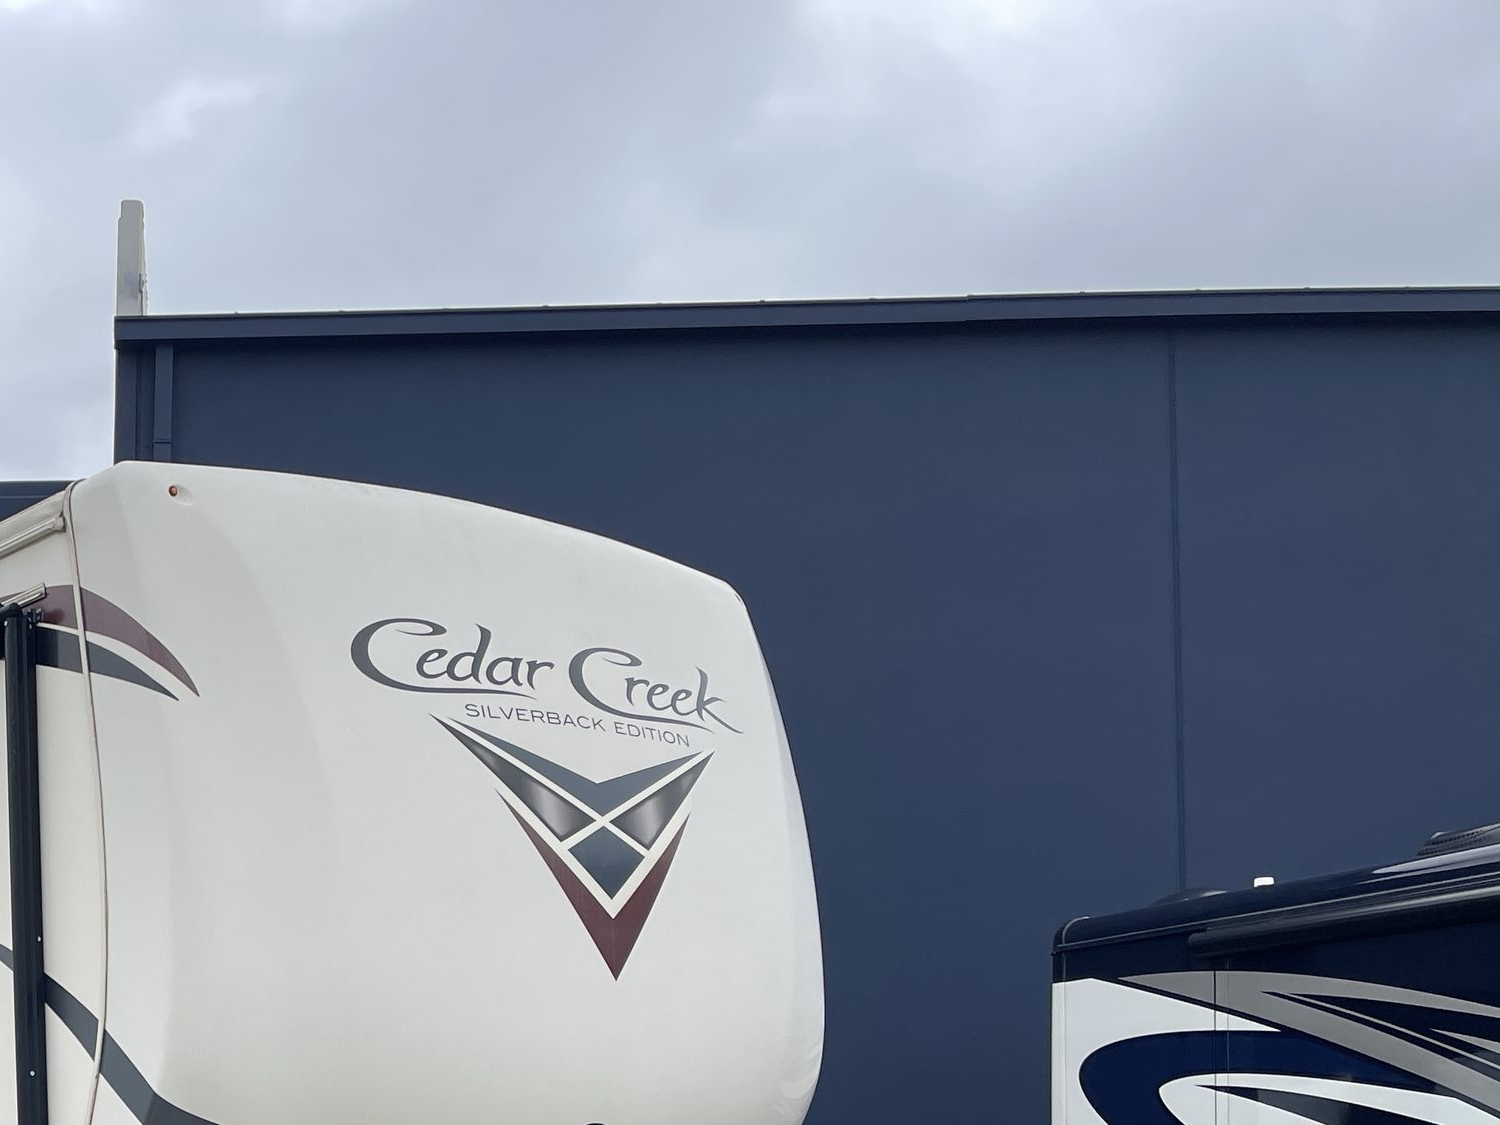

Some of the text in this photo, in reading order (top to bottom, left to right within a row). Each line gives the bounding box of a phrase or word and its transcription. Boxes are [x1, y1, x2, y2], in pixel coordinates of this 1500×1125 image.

[350, 617, 744, 734] Cedar Creek
[464, 703, 690, 748] SILVERBACK EDITION
